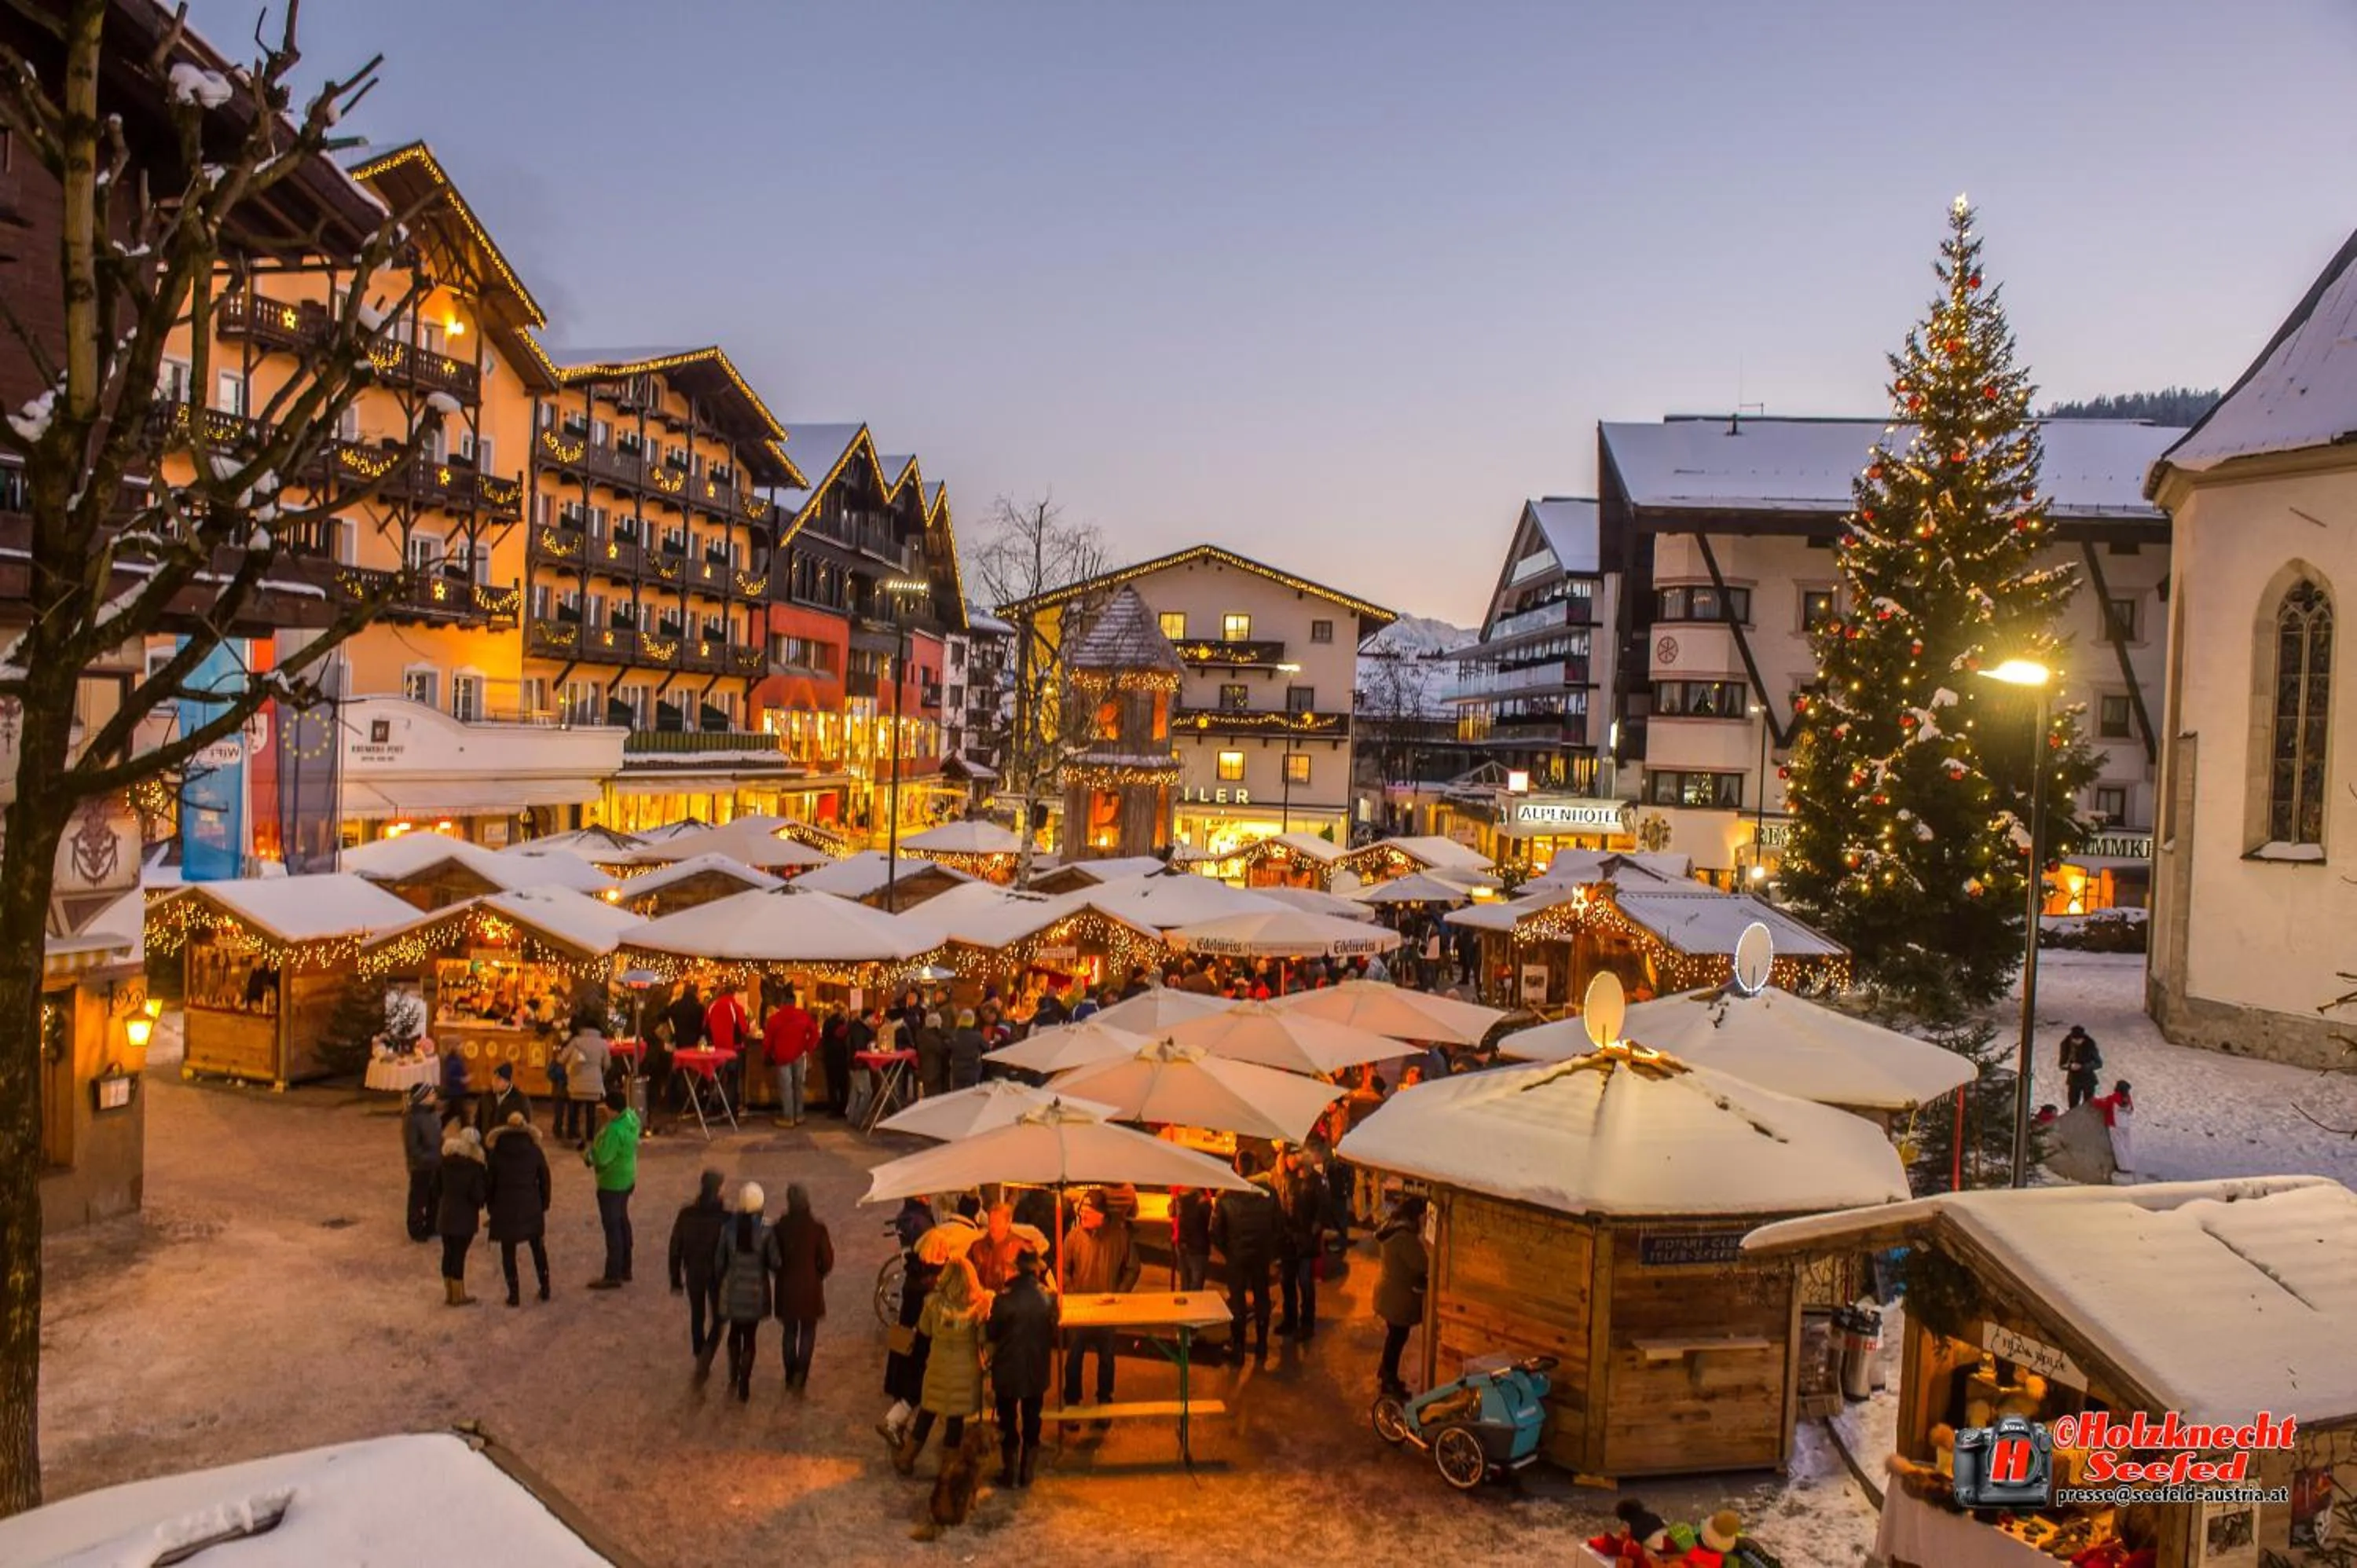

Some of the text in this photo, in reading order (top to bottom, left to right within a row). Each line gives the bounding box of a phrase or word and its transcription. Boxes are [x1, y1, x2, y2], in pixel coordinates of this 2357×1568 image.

[1183, 786, 1250, 804] ILER
[1519, 806, 1622, 823] ALPENHOTEL
[1197, 937, 1242, 954] Edelweiss
[1333, 937, 1376, 955] Edelweiss
